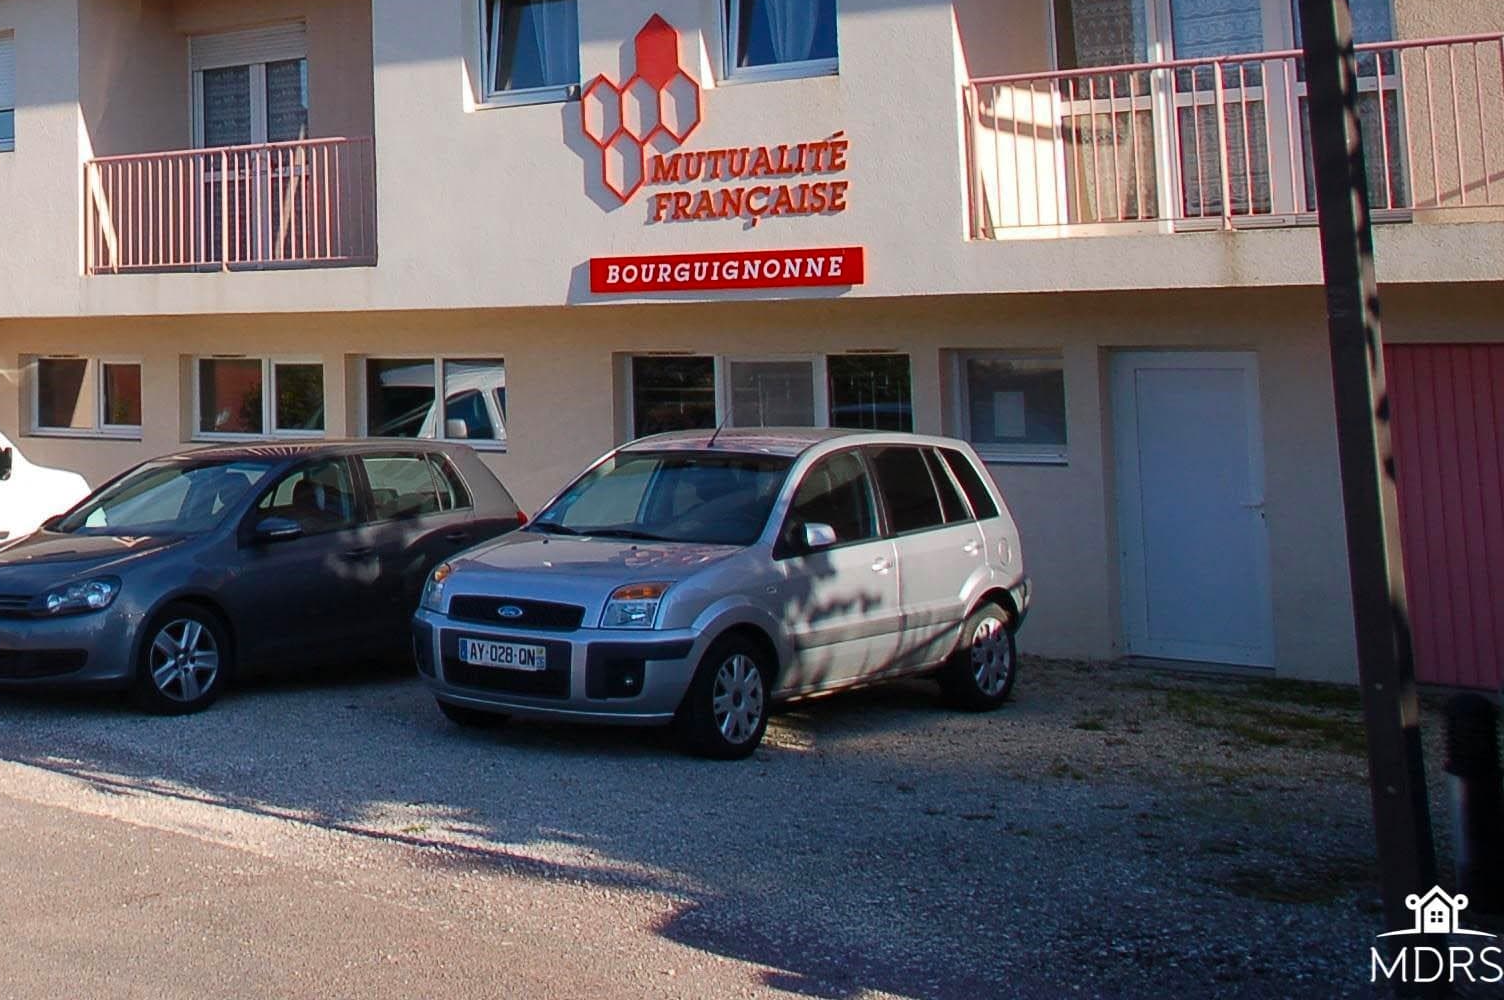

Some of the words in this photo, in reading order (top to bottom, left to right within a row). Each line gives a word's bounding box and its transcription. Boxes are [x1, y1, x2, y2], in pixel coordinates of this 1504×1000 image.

[651, 130, 849, 184] MUTUALITÉ
[652, 180, 849, 227] FRANÇAISE
[606, 255, 844, 285] BOURGUIGNONNE
